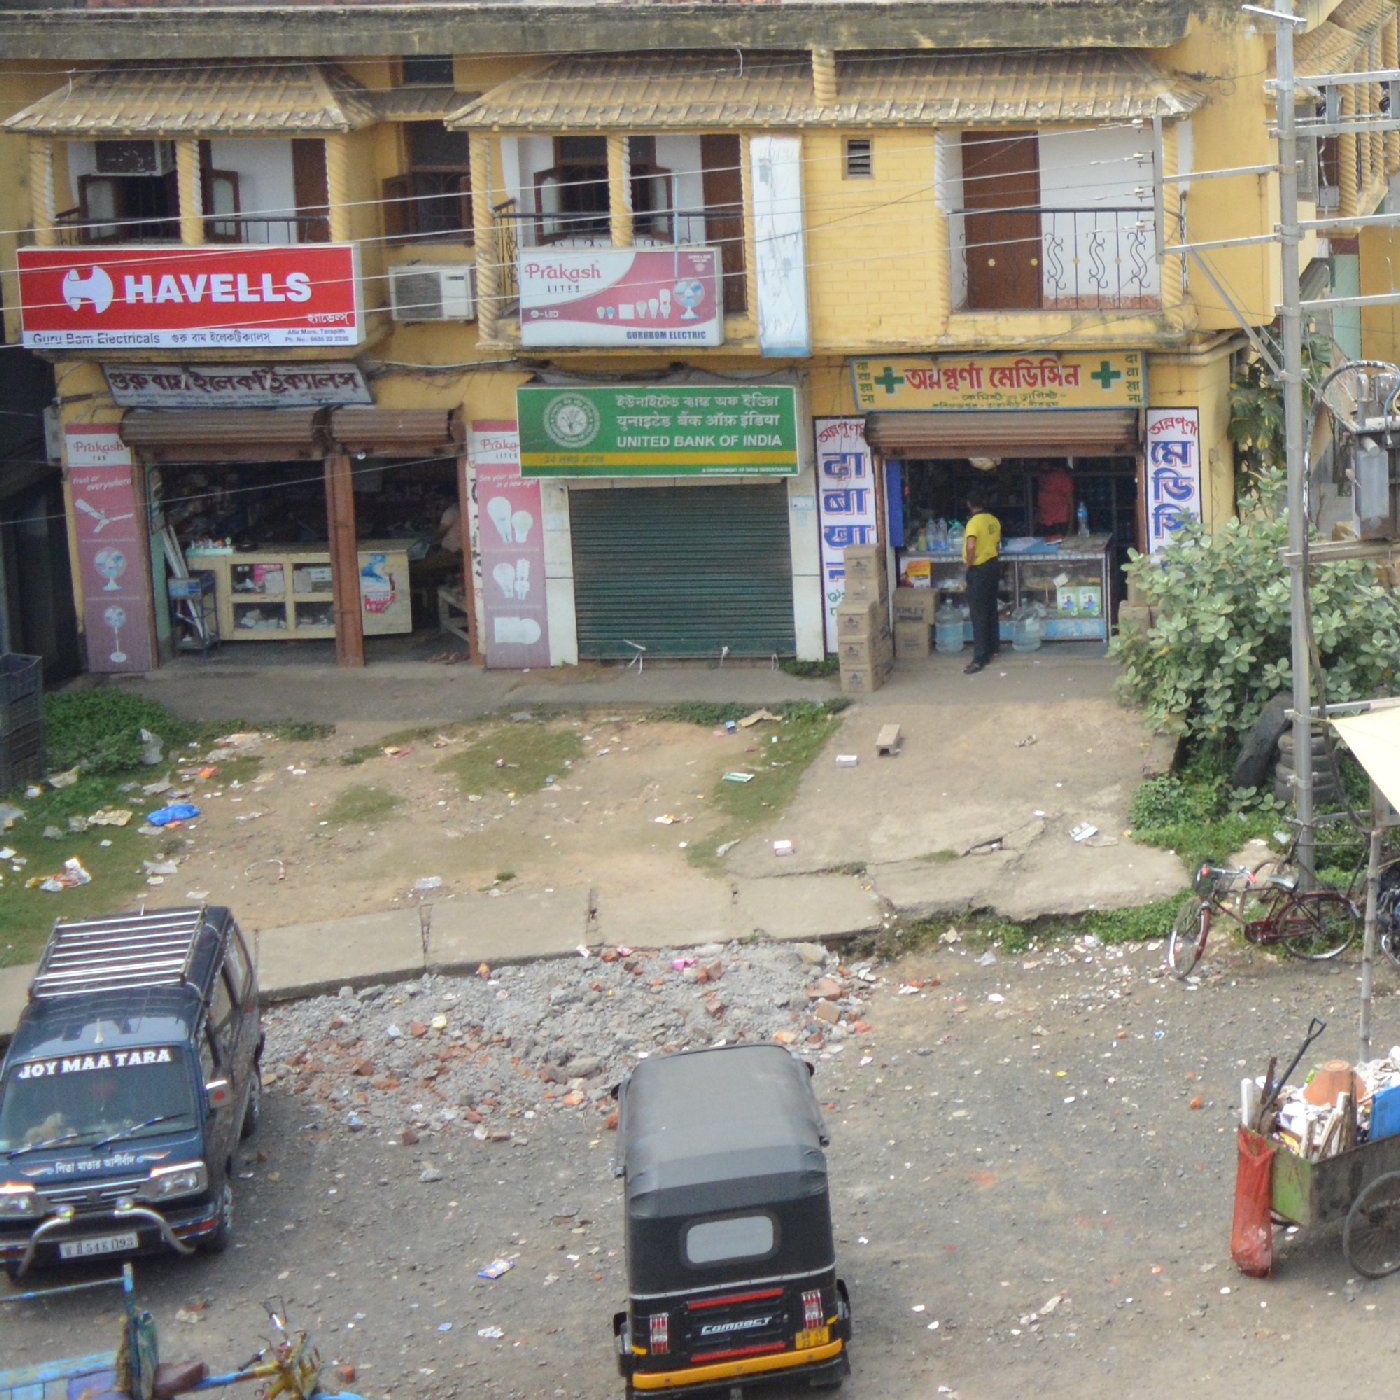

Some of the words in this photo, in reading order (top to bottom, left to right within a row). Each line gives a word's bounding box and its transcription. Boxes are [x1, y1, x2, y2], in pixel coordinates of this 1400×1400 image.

[524, 262, 602, 282] Prakash
[124, 272, 313, 304] HAVELLS
[97, 332, 160, 344] Electricals
[669, 330, 707, 340] ELECTRIC
[480, 438, 518, 451] Praka
[617, 436, 670, 447] UNITED
[674, 435, 715, 447] BANK
[719, 435, 739, 447] OF
[743, 434, 783, 446] INDIA
[73, 441, 125, 455] Prakash
[18, 1061, 58, 1079] JOY
[61, 1053, 112, 1073] MAA
[115, 1049, 172, 1067] TARA
